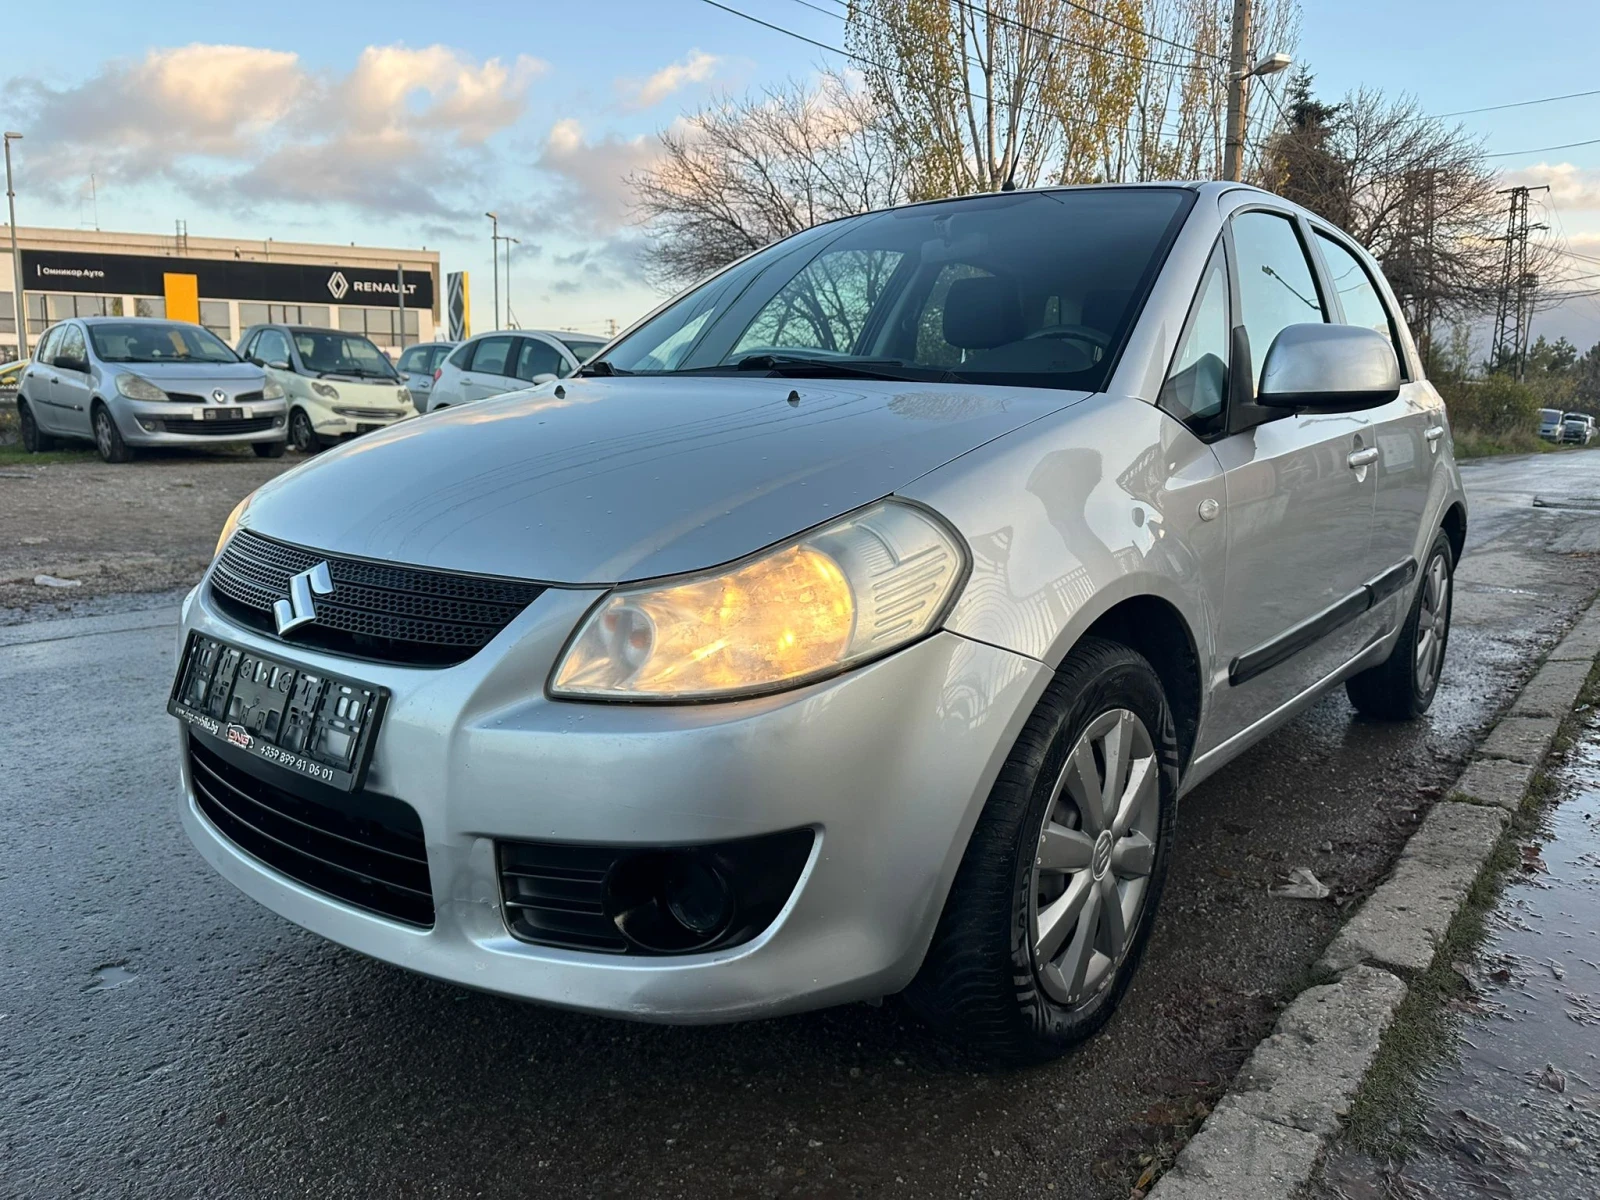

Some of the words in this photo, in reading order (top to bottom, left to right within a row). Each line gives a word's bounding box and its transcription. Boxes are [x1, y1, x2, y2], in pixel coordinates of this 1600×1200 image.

[42, 267, 82, 278] Омникор
[83, 269, 104, 279] Ауто
[353, 281, 417, 294] RENAULT
[260, 745, 280, 760] +359
[279, 752, 296, 766] 899
[296, 758, 307, 772] 41
[309, 763, 321, 776] 06
[322, 768, 334, 781] 01
